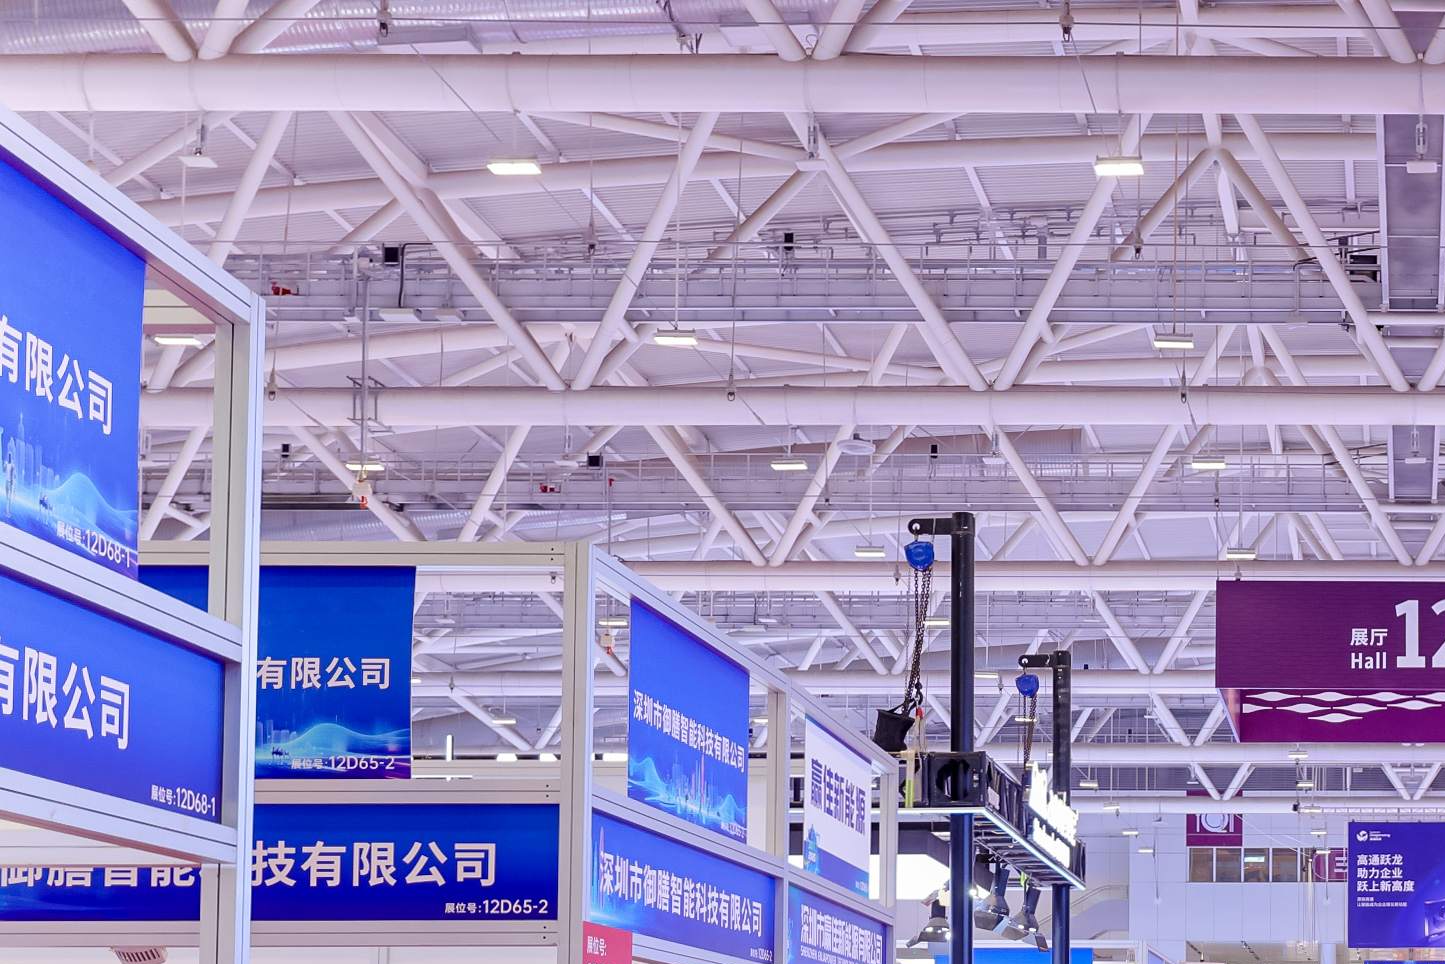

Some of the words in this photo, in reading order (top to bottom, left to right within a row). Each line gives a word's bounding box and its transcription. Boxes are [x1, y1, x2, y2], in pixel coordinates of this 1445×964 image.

[0, 315, 112, 435] 有限公司
[1350, 628, 1388, 647] 展厅
[1350, 652, 1387, 670] Hall
[256, 656, 391, 690] 有限公司
[633, 689, 745, 773] 深圳市御膳智能科技有限公司
[291, 756, 396, 771] 展位号:12D65-2
[151, 784, 216, 816] 展位号:12D68-1
[246, 841, 497, 888] 技有限公司
[1356, 854, 1404, 866] 高通跃龙
[1356, 867, 1403, 879] 助力企业
[600, 850, 762, 938] 深圳市御膳智能科技有限公司
[1356, 880, 1415, 892] 跃上新高度
[445, 899, 549, 915] 展位号:12D65-2
